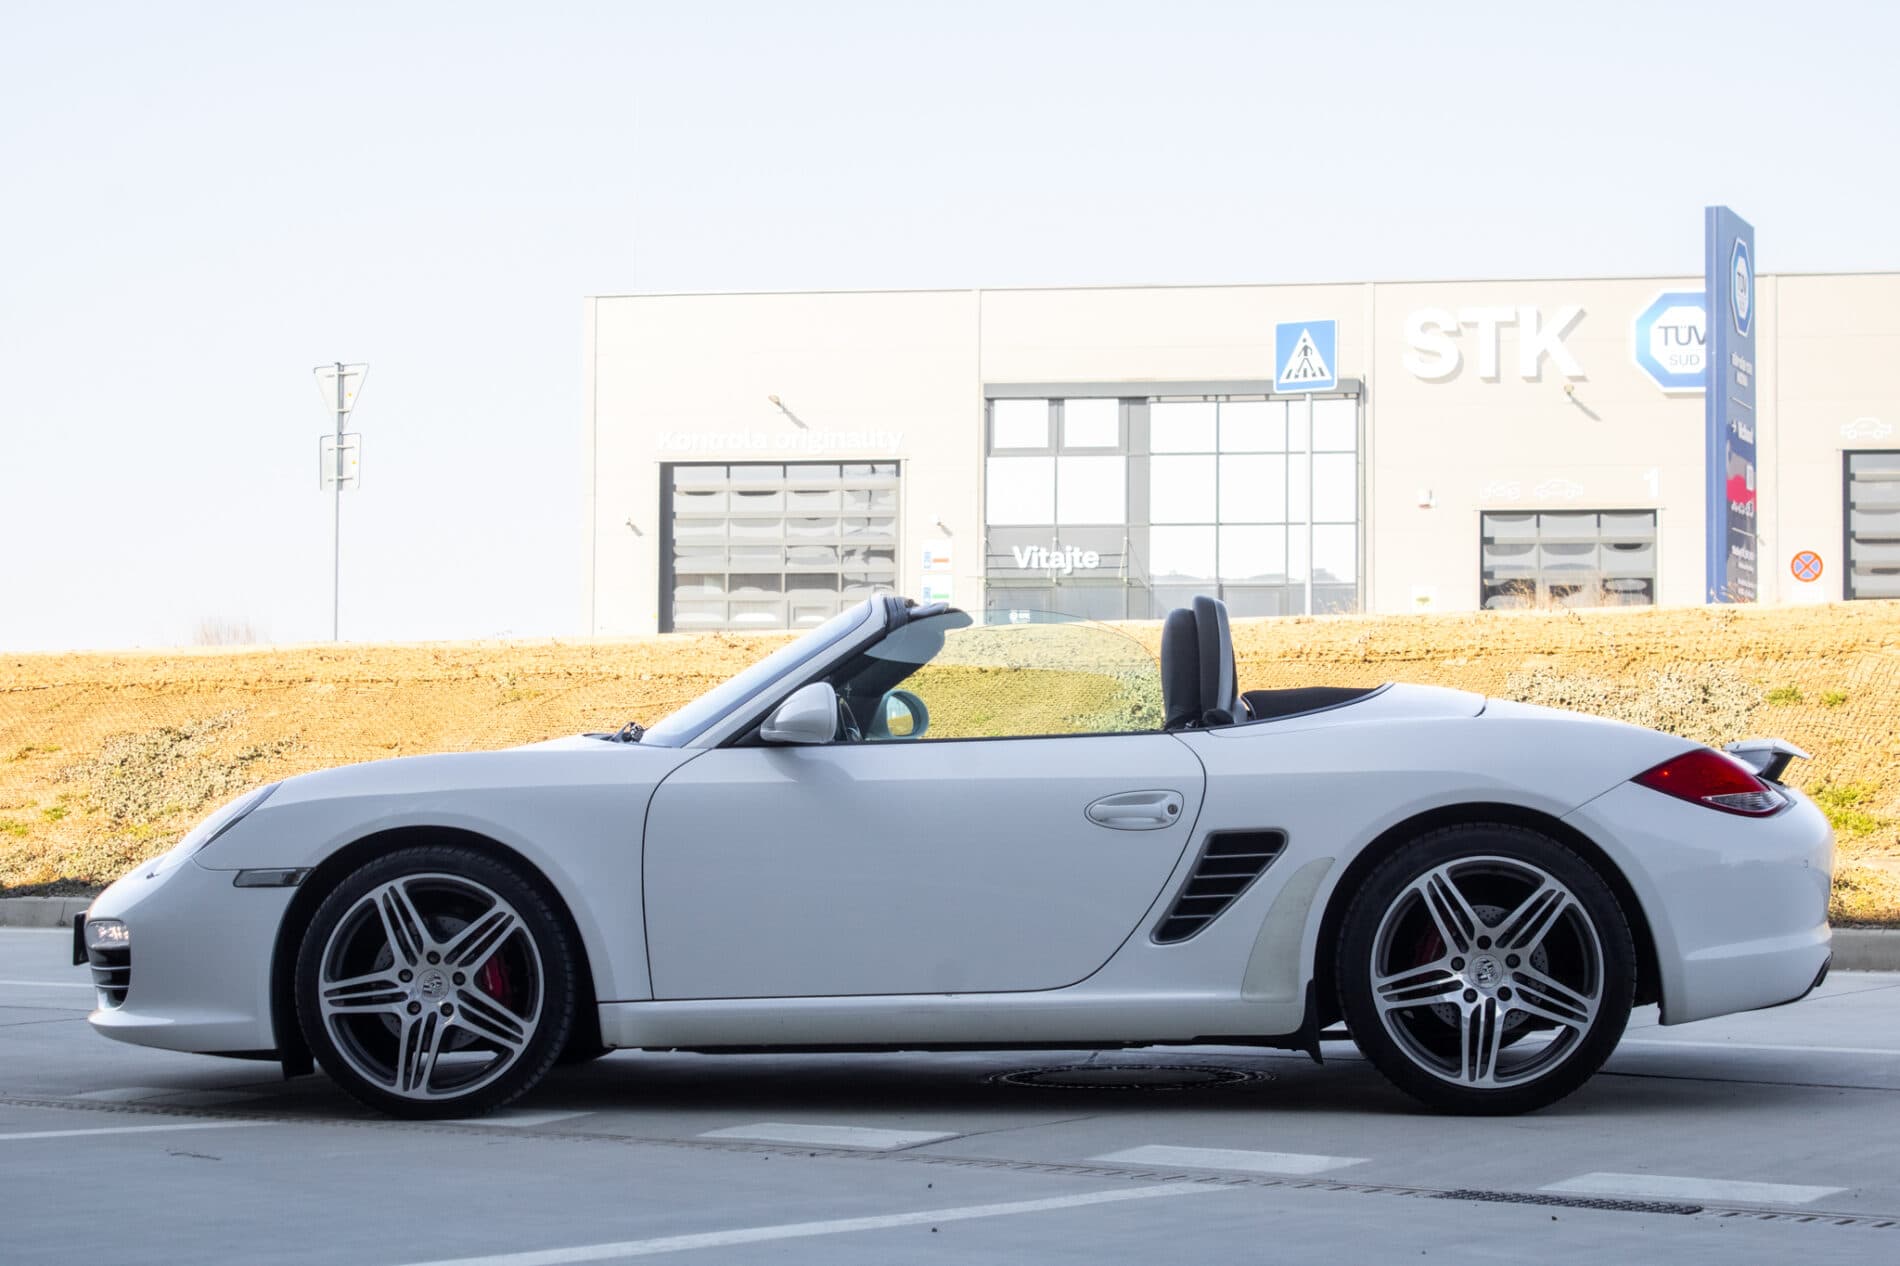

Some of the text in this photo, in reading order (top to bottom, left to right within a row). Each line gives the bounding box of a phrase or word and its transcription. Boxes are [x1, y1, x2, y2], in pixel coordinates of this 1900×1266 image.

[1402, 304, 1586, 382] STK
[1658, 323, 1707, 347] TÜV
[656, 425, 769, 450] Kontrola
[1642, 466, 1660, 498] 1
[1012, 545, 1100, 575] Vitajte
